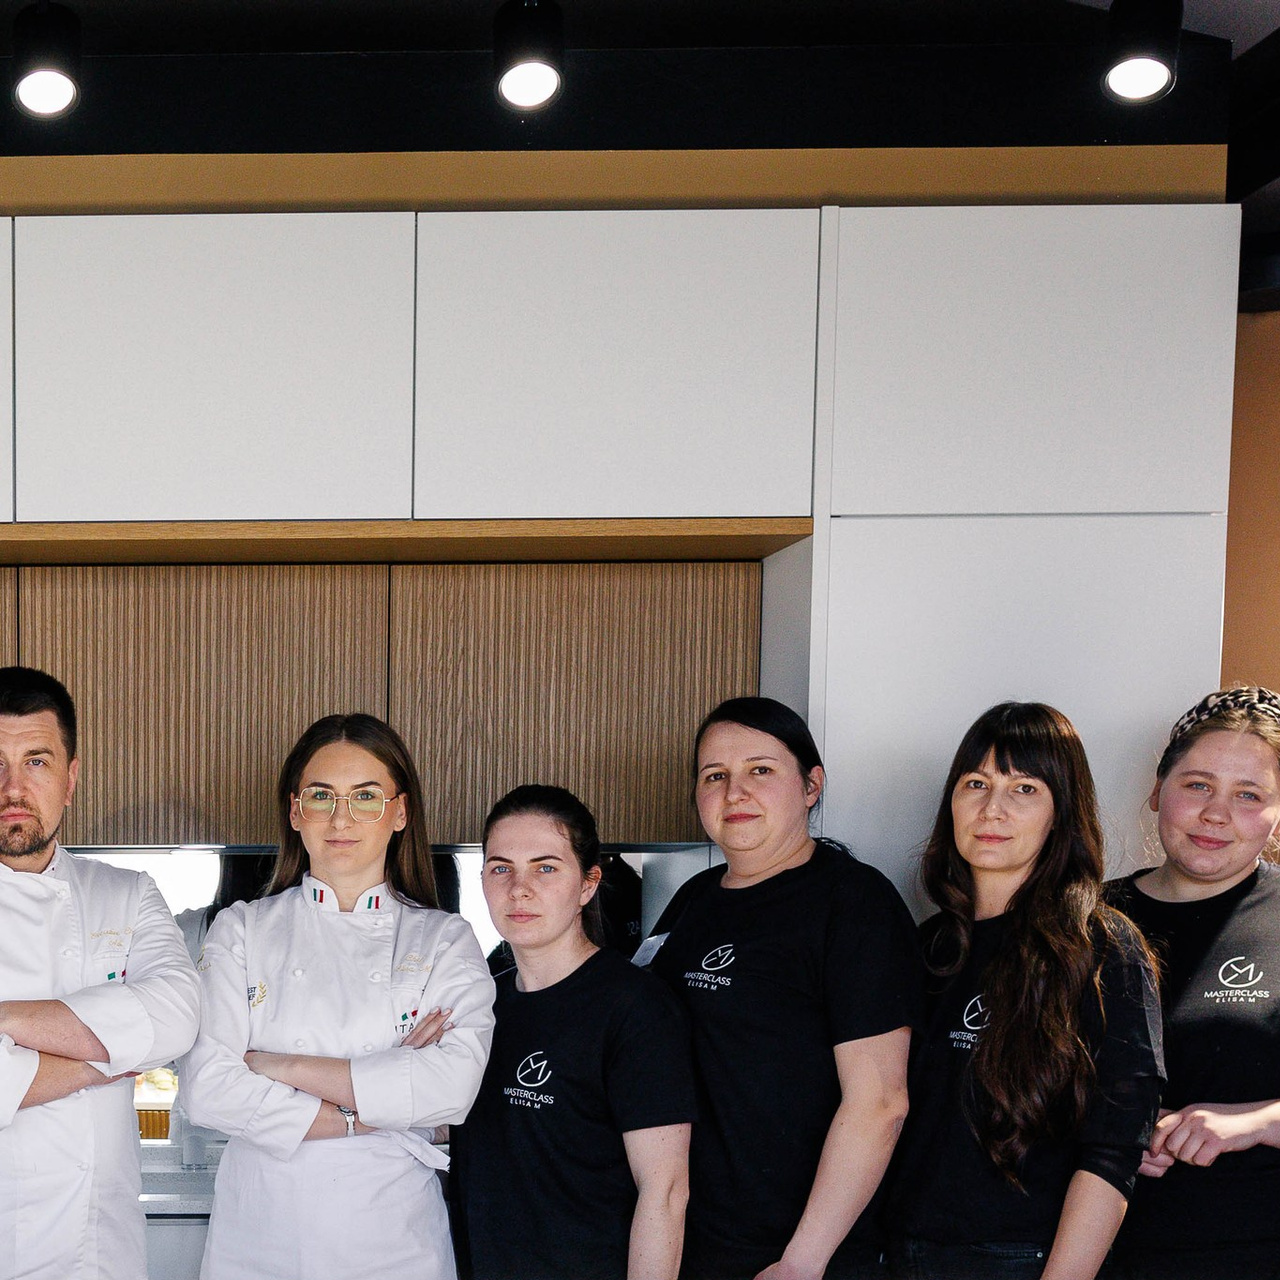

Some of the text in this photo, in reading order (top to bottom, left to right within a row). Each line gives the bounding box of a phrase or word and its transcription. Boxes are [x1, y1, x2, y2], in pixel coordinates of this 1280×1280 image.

[683, 971, 732, 986] MASTERCLASS
[687, 979, 708, 989] ELISA
[1203, 989, 1270, 998] MASTERCLASS
[503, 1087, 555, 1104] MASTERCLASS
[510, 1097, 541, 1110] ELISA M
